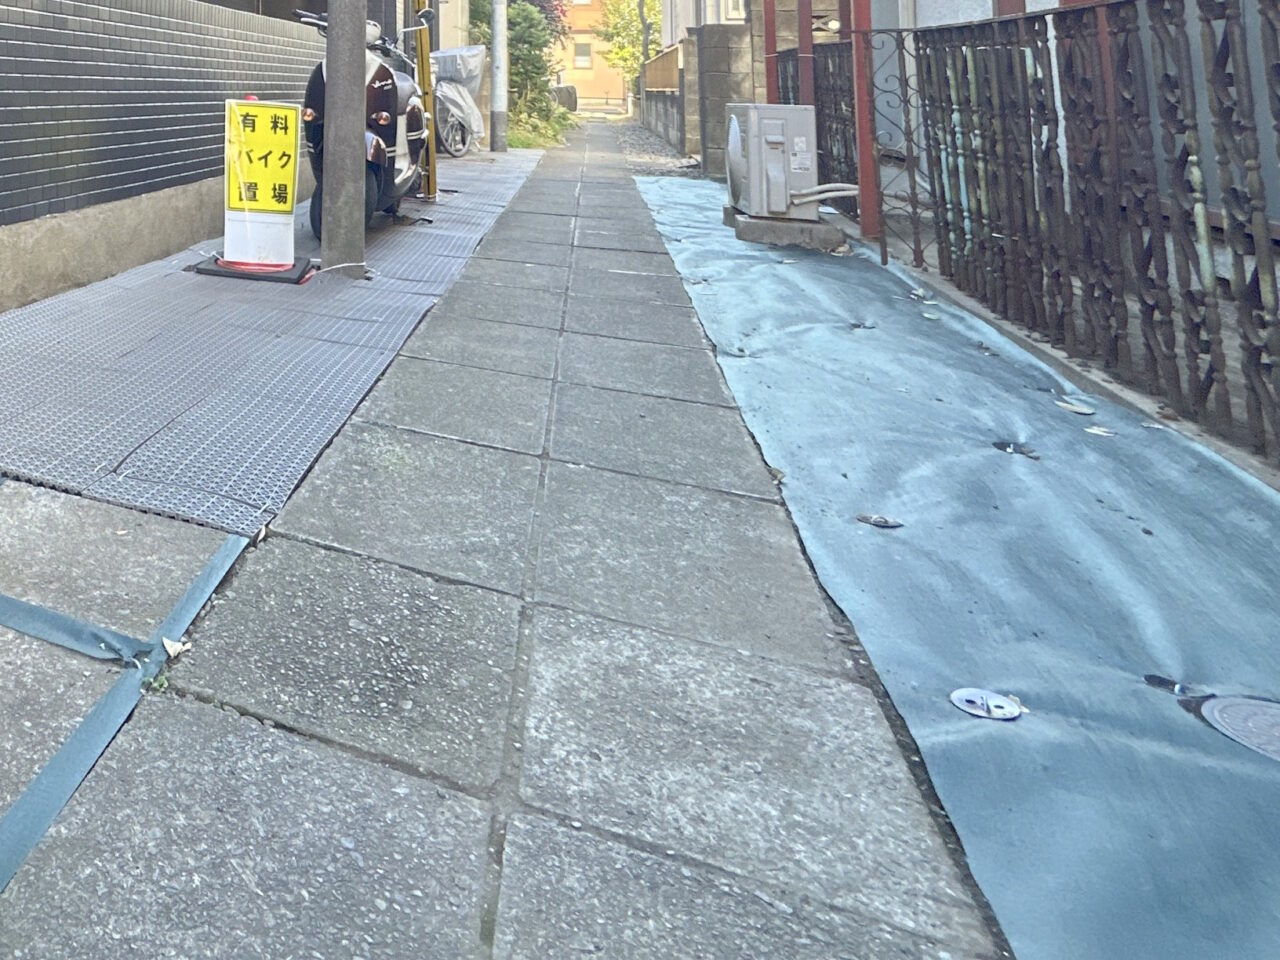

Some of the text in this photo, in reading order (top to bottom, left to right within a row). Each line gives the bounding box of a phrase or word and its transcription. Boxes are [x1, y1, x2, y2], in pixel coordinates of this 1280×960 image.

[238, 112, 289, 135] 有料
[237, 149, 292, 169] バイク
[238, 182, 288, 204] 置場
